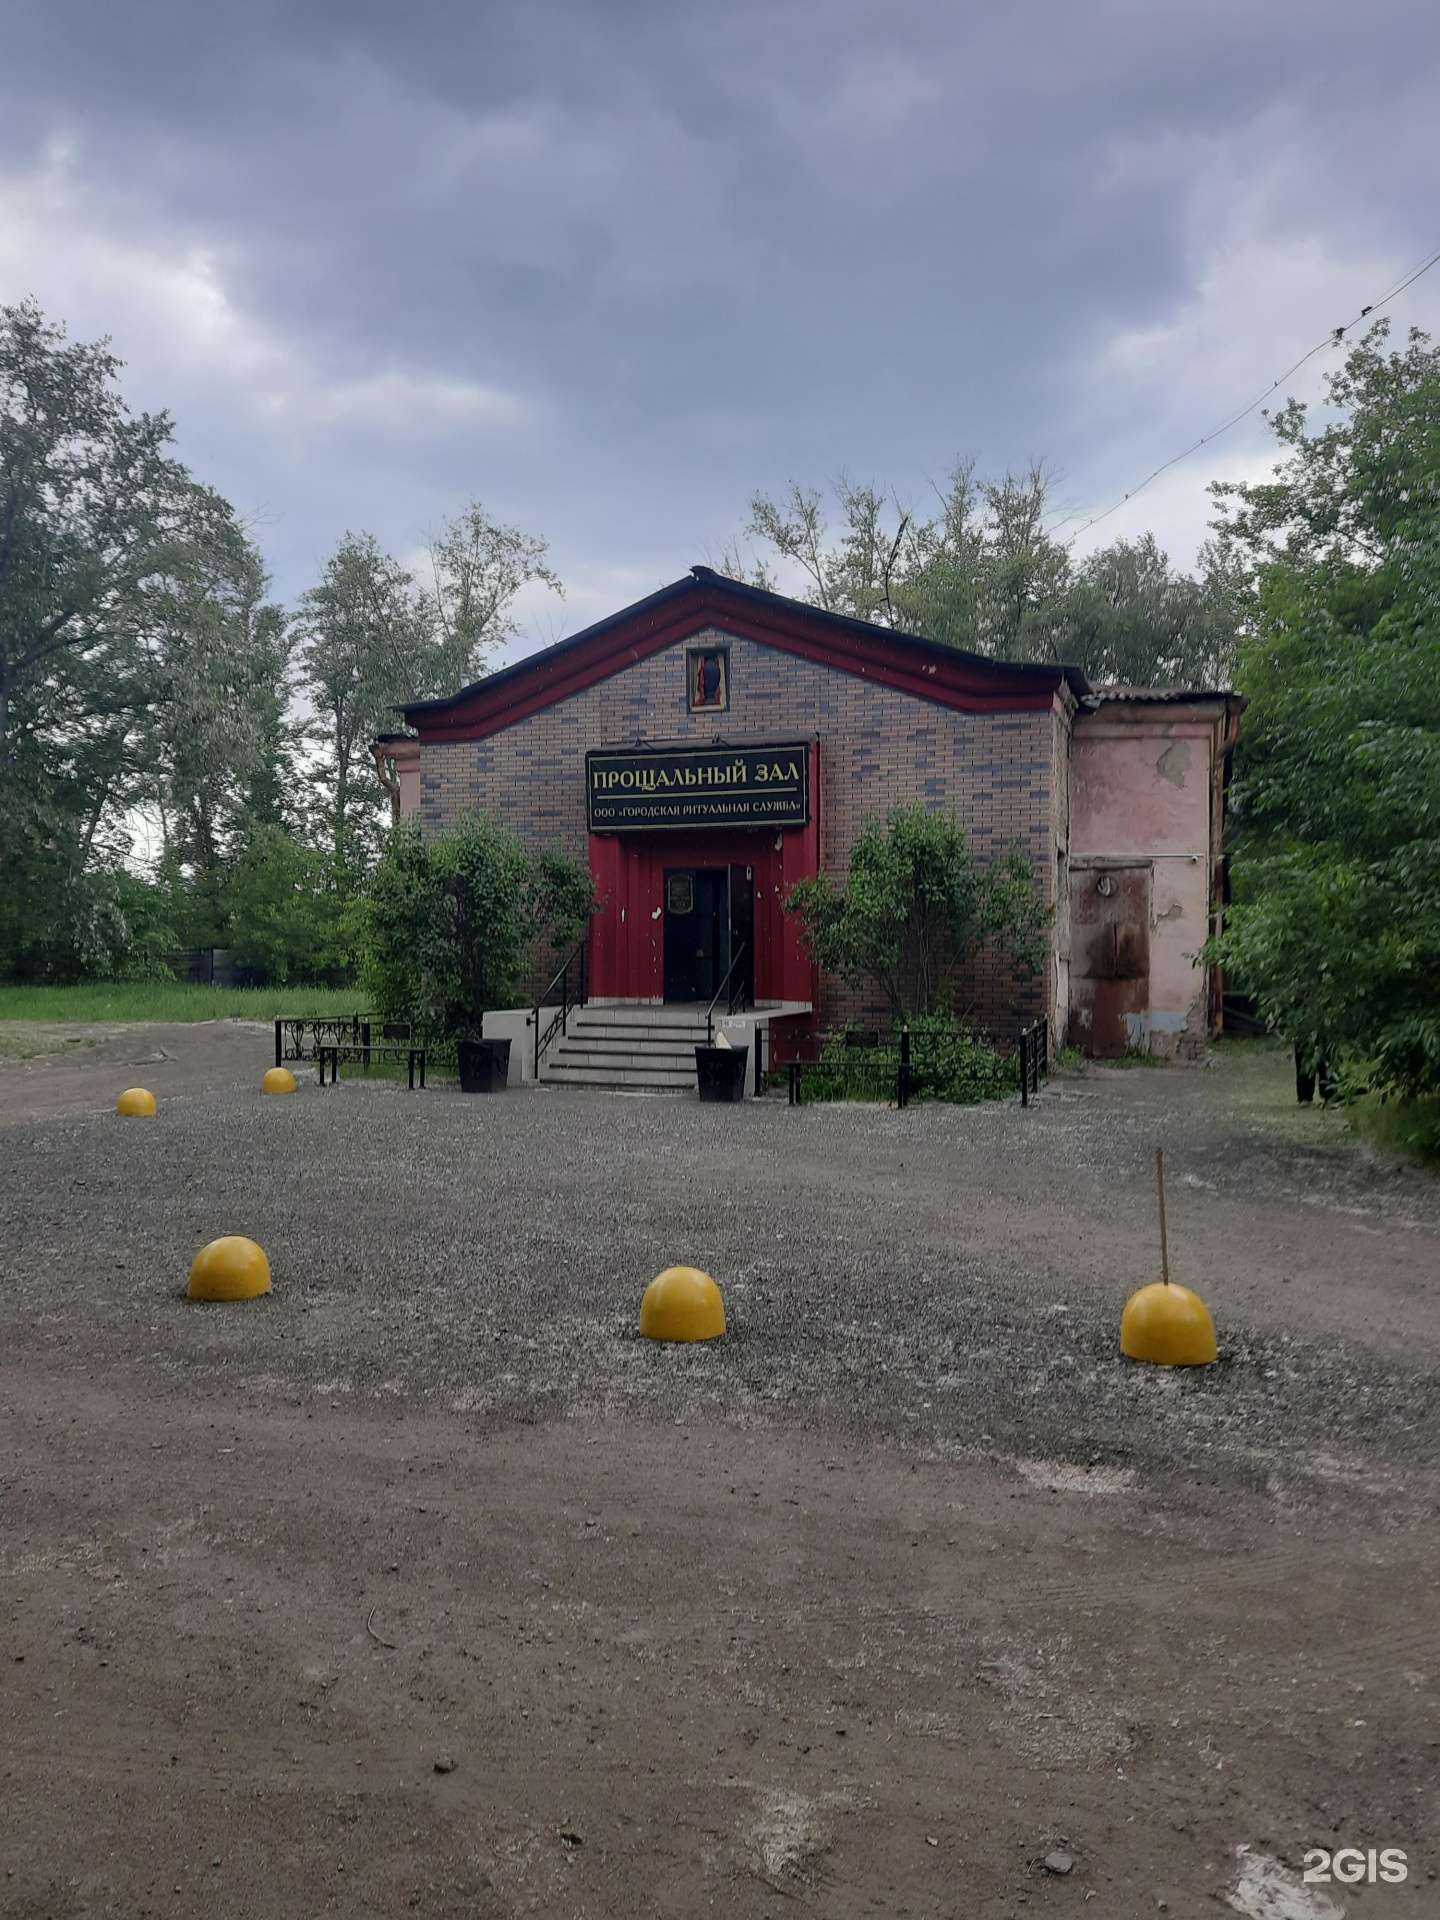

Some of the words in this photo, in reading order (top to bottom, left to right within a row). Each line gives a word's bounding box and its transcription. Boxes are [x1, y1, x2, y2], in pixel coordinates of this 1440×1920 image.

[593, 759, 747, 791] ПРОЩАЛЬНЫЙ
[754, 762, 800, 782] ЗАЛ
[594, 807, 616, 817] ООО
[683, 802, 750, 815] РИТУАЛЬНАЯ
